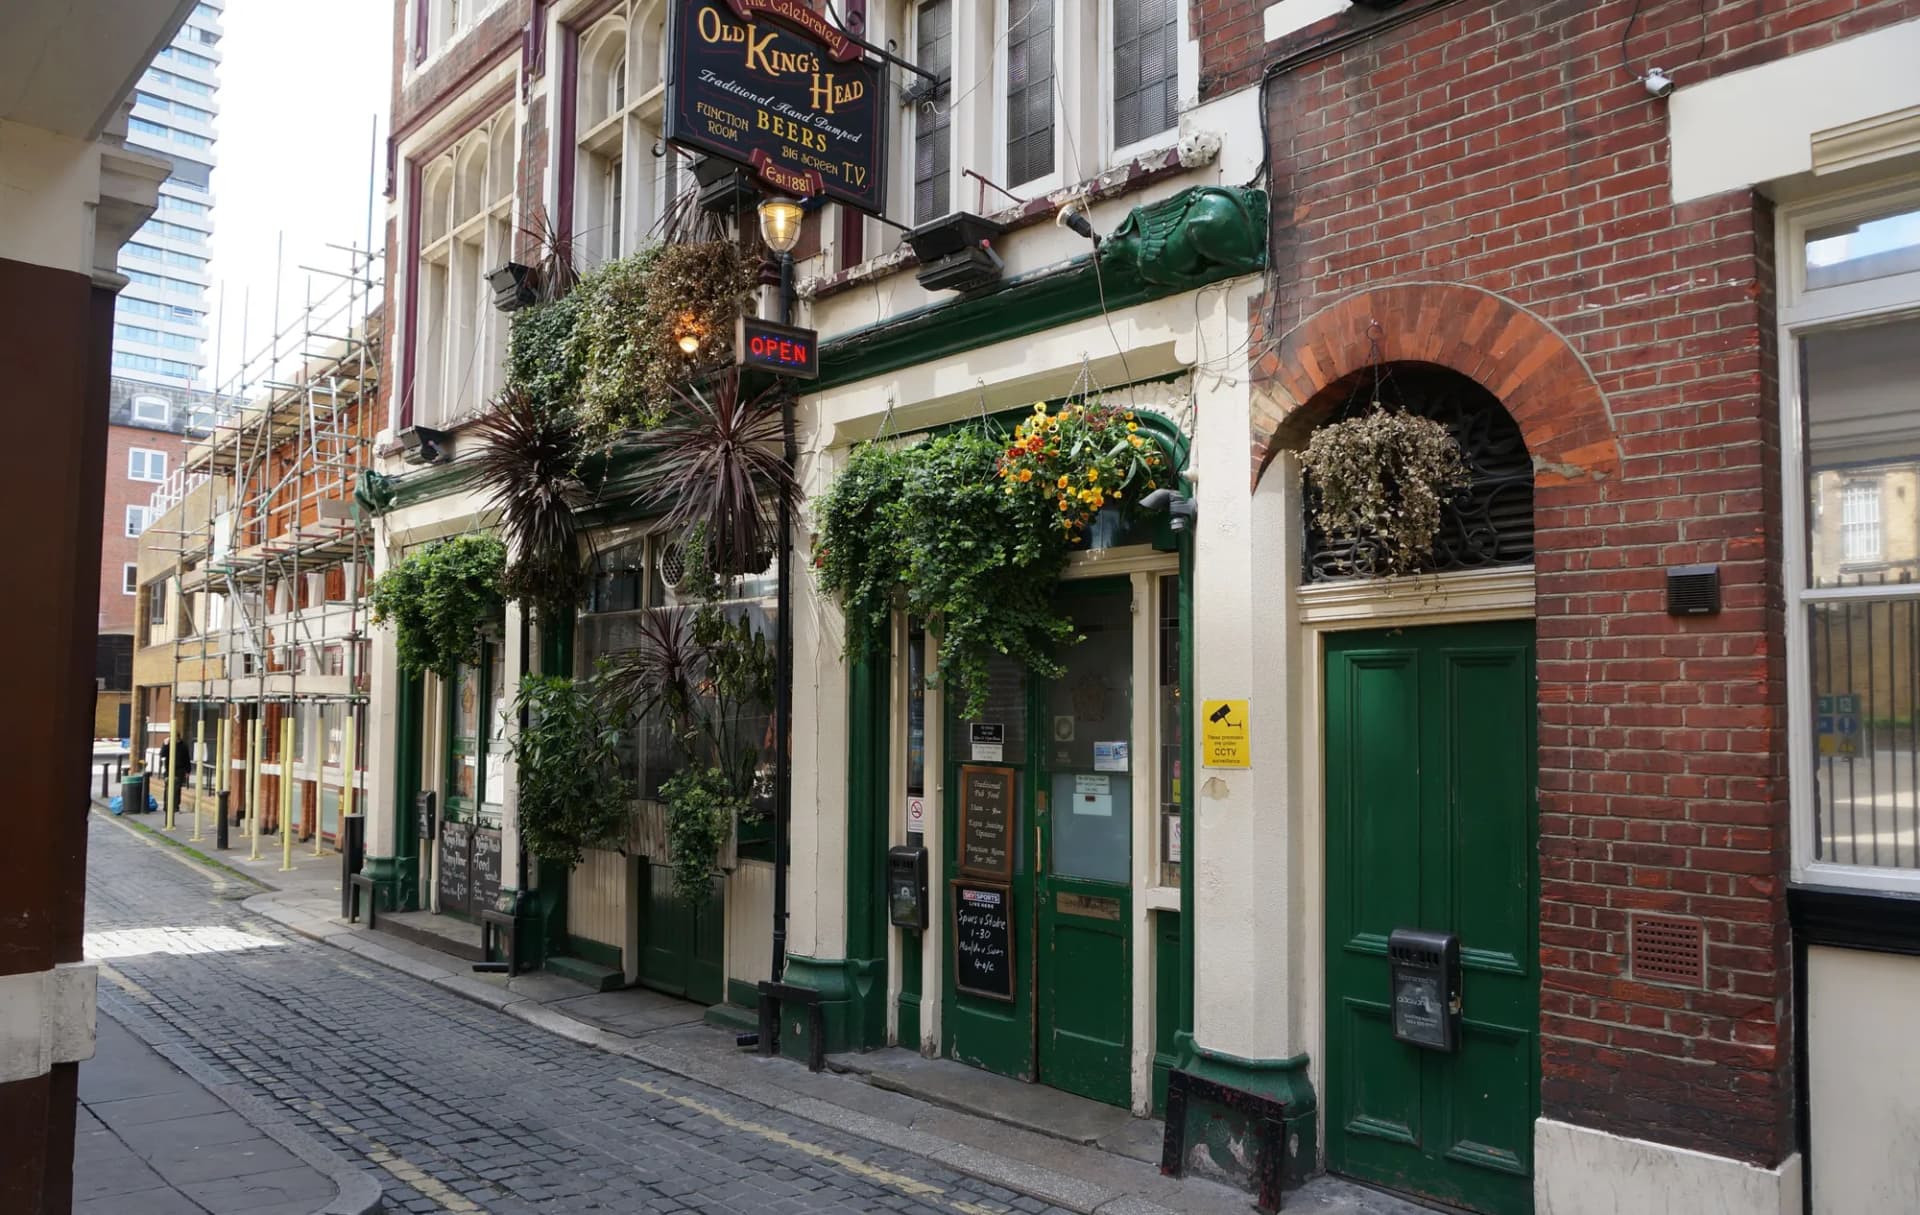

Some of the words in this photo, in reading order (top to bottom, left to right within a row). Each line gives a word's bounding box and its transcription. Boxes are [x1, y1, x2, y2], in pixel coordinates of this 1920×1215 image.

[771, 0, 841, 48] Celebrated
[696, 102, 749, 132] FUNCTION
[698, 69, 775, 107] Traditional
[772, 102, 814, 124] Hand
[814, 116, 863, 144] Pumped
[708, 120, 738, 142] ROOM
[756, 109, 828, 153] BEERS
[782, 145, 799, 160] BIG
[751, 337, 807, 363] OPEN
[1214, 748, 1237, 756] CCTV
[976, 893, 999, 903] SPORTS
[958, 909, 977, 925] Spurs
